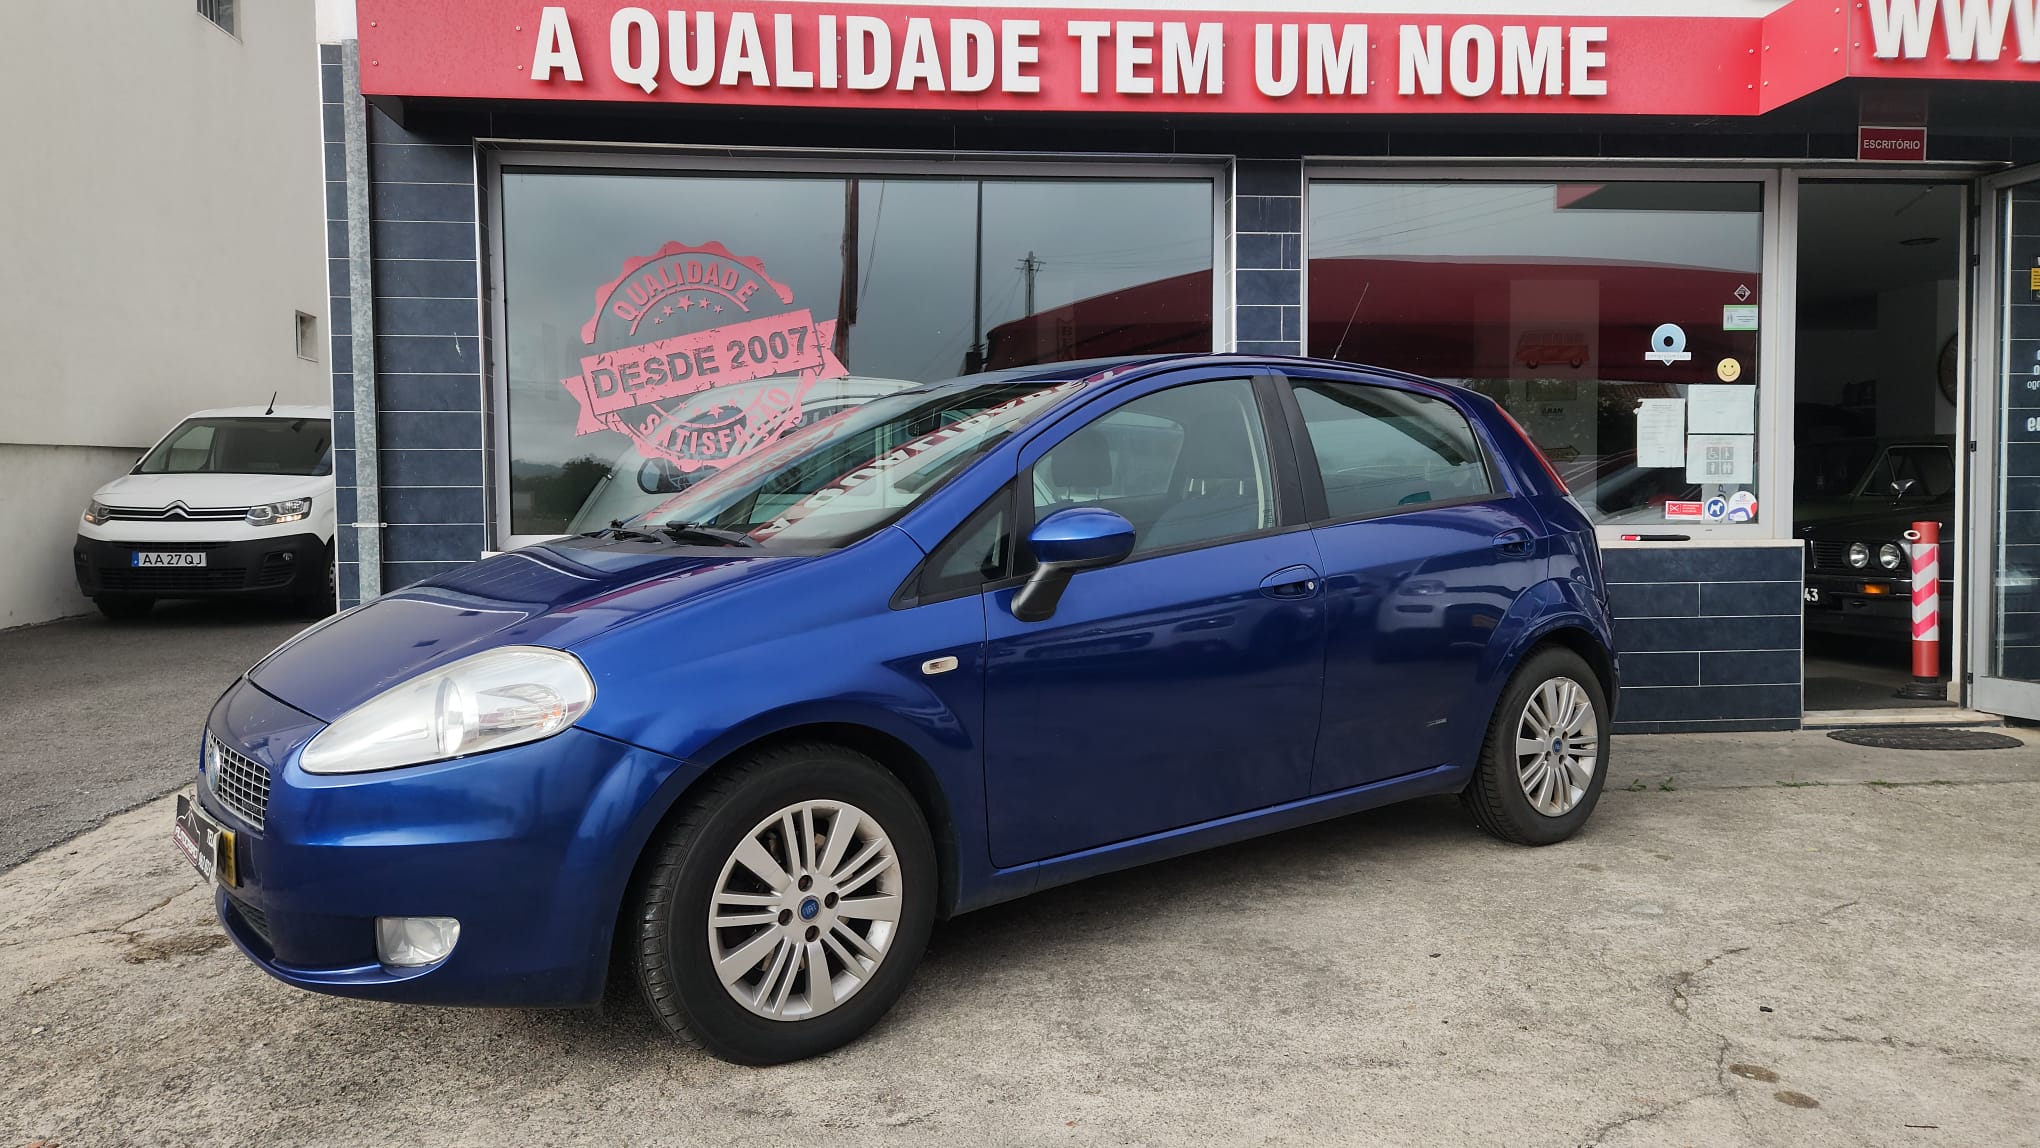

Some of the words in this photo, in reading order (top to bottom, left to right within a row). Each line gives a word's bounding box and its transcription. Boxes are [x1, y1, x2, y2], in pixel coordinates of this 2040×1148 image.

[530, 6, 583, 82] A
[609, 7, 1041, 95] QUALIDADE
[1067, 20, 1224, 95] TEM
[1255, 23, 1369, 98] UM
[1399, 25, 1609, 98] NOME
[1863, 138, 1921, 150] ESCRITÓRIO
[612, 260, 760, 322] QUALIDADE
[590, 344, 720, 399] DESDE
[726, 326, 809, 369] 2007
[639, 386, 792, 456] SATISFAÇÃO
[142, 554, 164, 565] AA
[166, 554, 182, 565] 27
[184, 554, 202, 566] QJ
